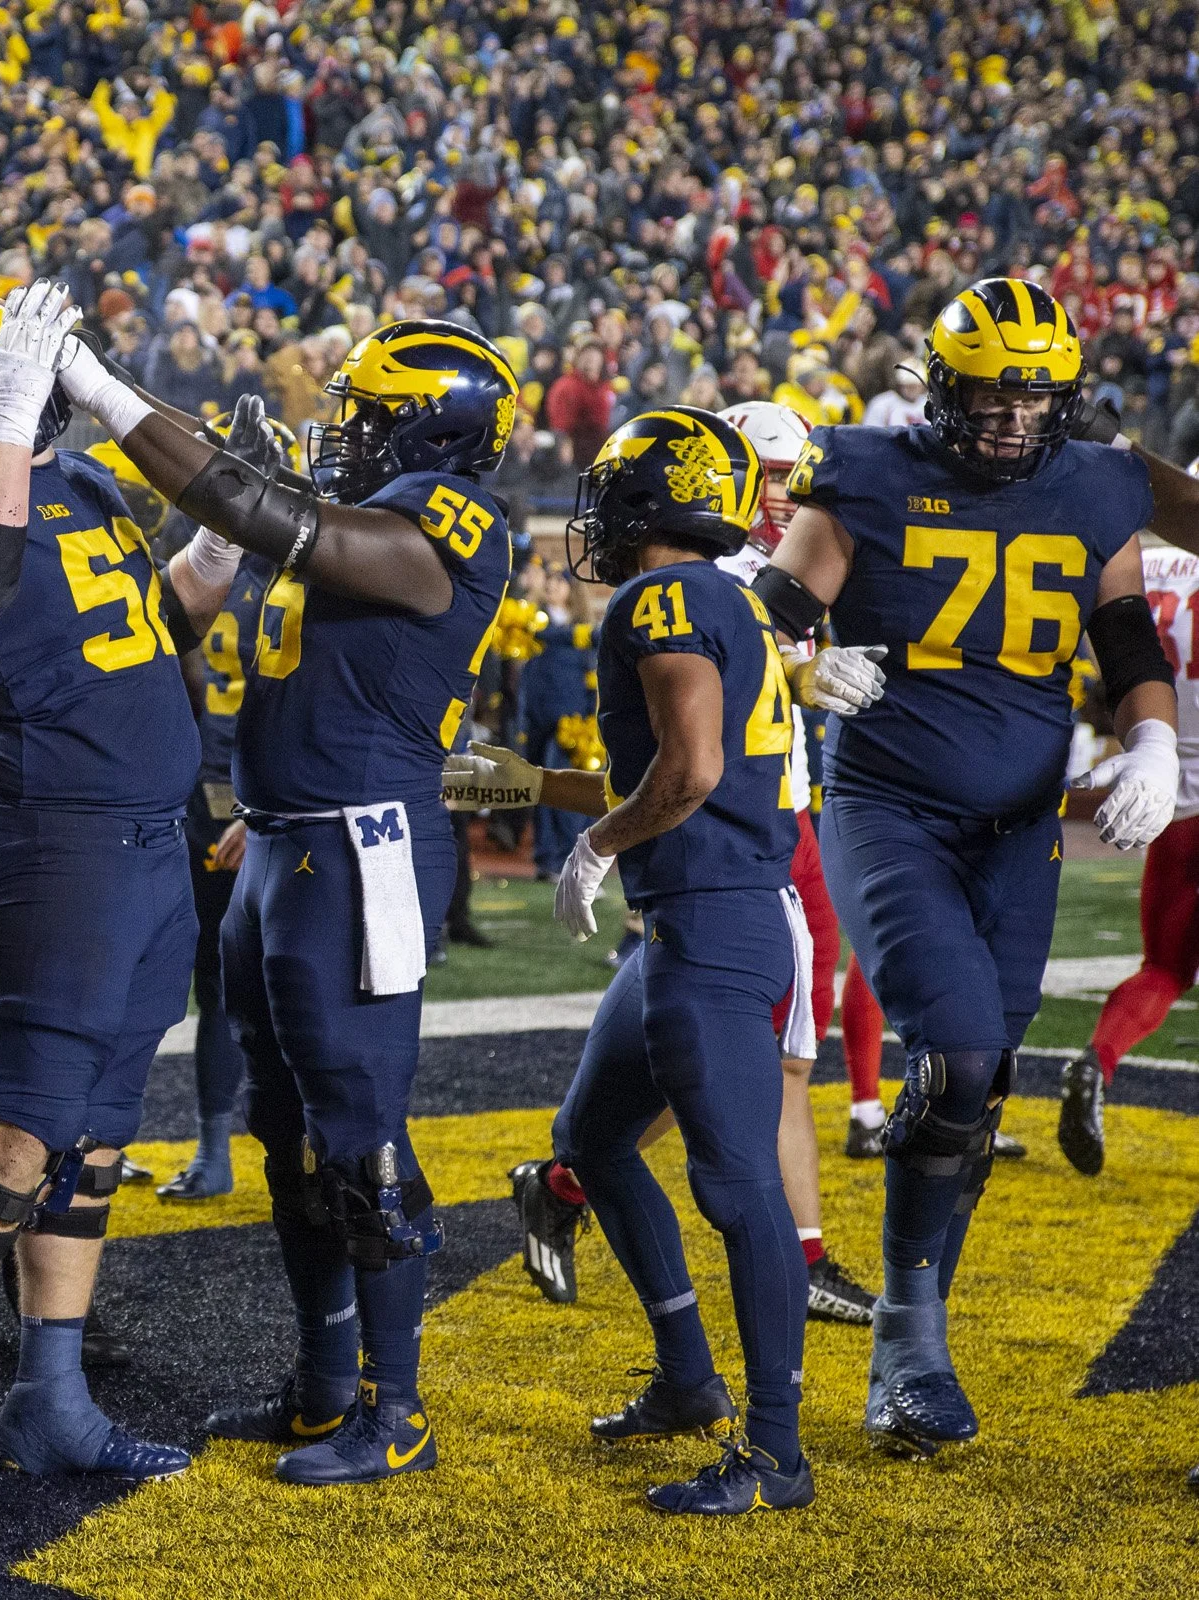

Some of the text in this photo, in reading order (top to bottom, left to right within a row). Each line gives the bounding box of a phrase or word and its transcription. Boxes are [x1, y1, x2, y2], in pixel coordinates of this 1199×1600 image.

[1021, 367, 1038, 380] M
[420, 485, 495, 559] 55
[632, 581, 693, 640] 41
[903, 526, 1087, 677] 76
[355, 808, 404, 849] M
